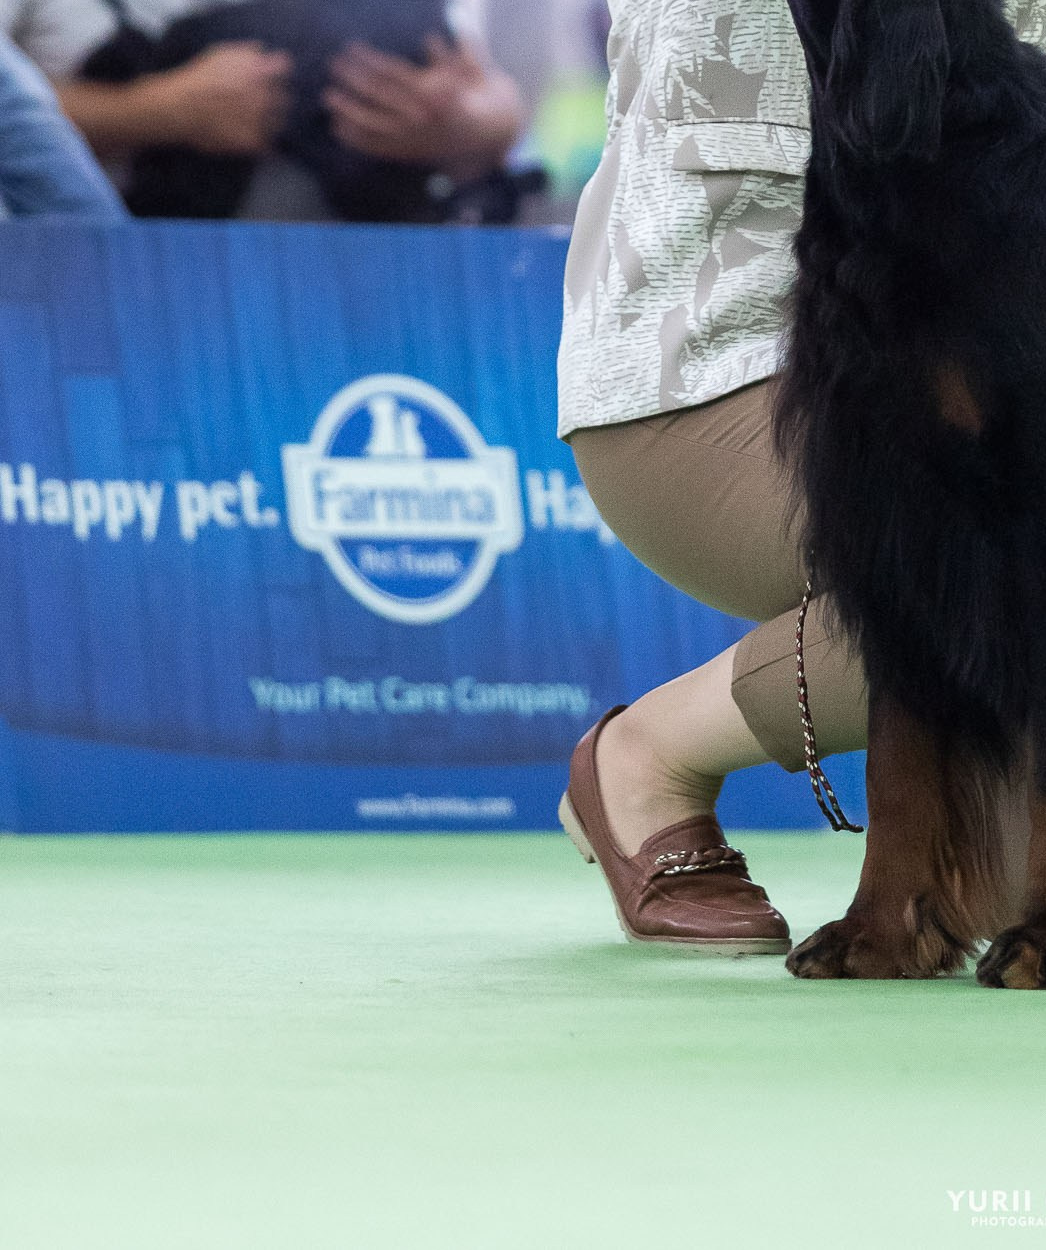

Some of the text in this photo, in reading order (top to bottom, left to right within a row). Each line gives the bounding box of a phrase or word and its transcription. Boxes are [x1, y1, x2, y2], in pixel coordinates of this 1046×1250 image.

[0, 463, 280, 543] Happy pet.
[312, 468, 496, 524] Farmina
[250, 676, 321, 713] Your
[323, 676, 379, 713] Pet
[381, 676, 449, 714] Care
